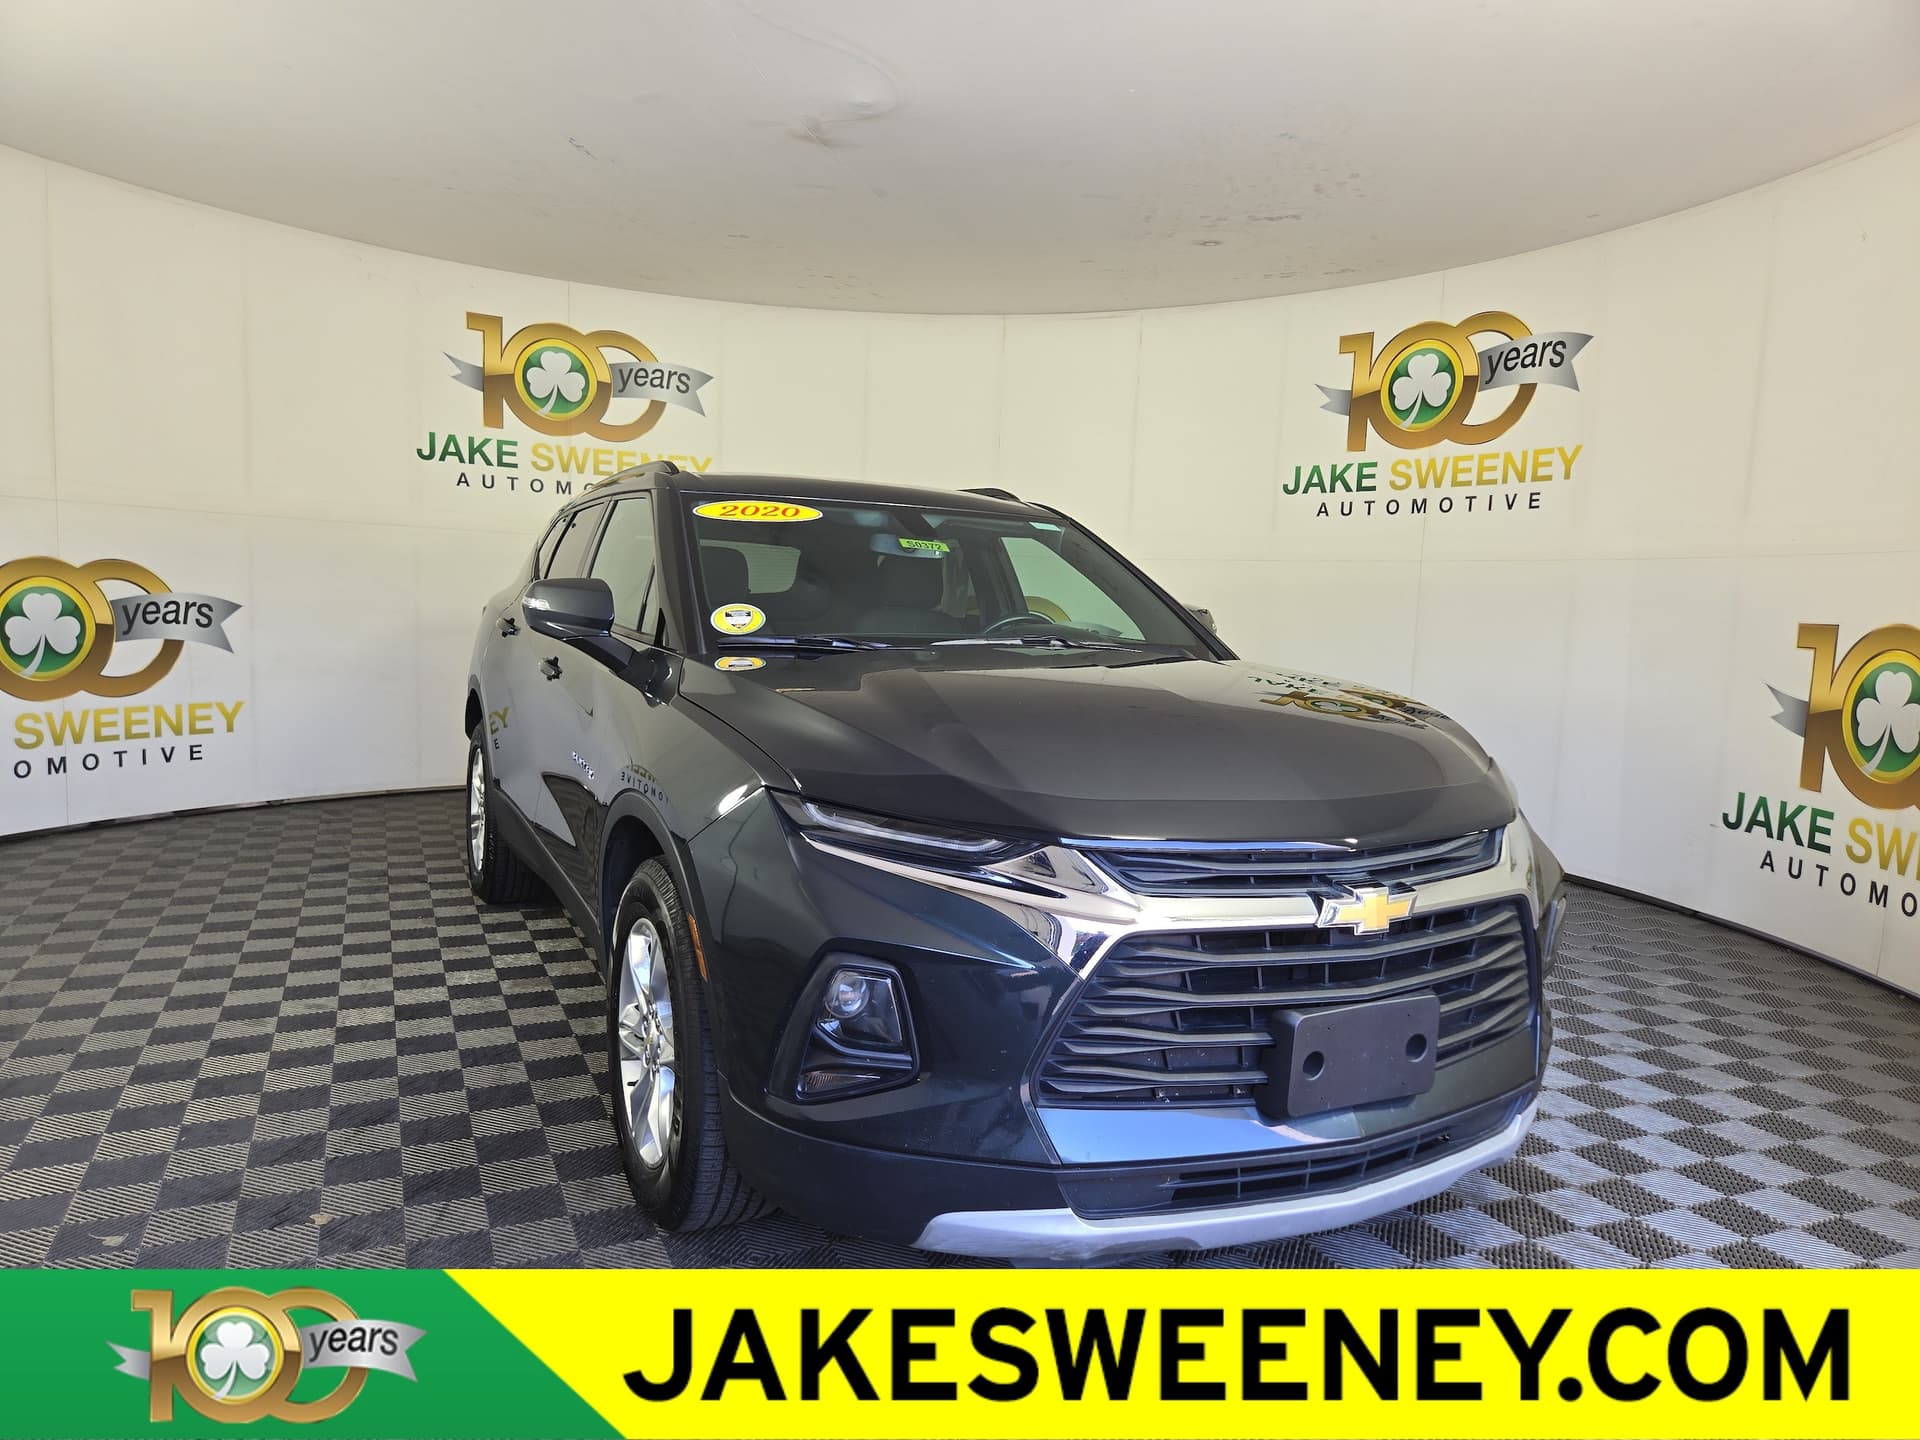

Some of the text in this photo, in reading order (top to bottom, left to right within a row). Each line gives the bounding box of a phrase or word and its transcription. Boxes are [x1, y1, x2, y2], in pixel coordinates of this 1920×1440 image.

[617, 365, 691, 394] years
[1484, 339, 1568, 385] years
[416, 431, 519, 469] JAKE
[1282, 444, 1584, 495] JAKE SWEENEY
[719, 504, 801, 518] 2020
[1317, 492, 1542, 517] AUTOMOTIVE
[121, 599, 215, 636] years
[14, 701, 246, 750] SWEENEY
[1721, 791, 1835, 854] JAKE
